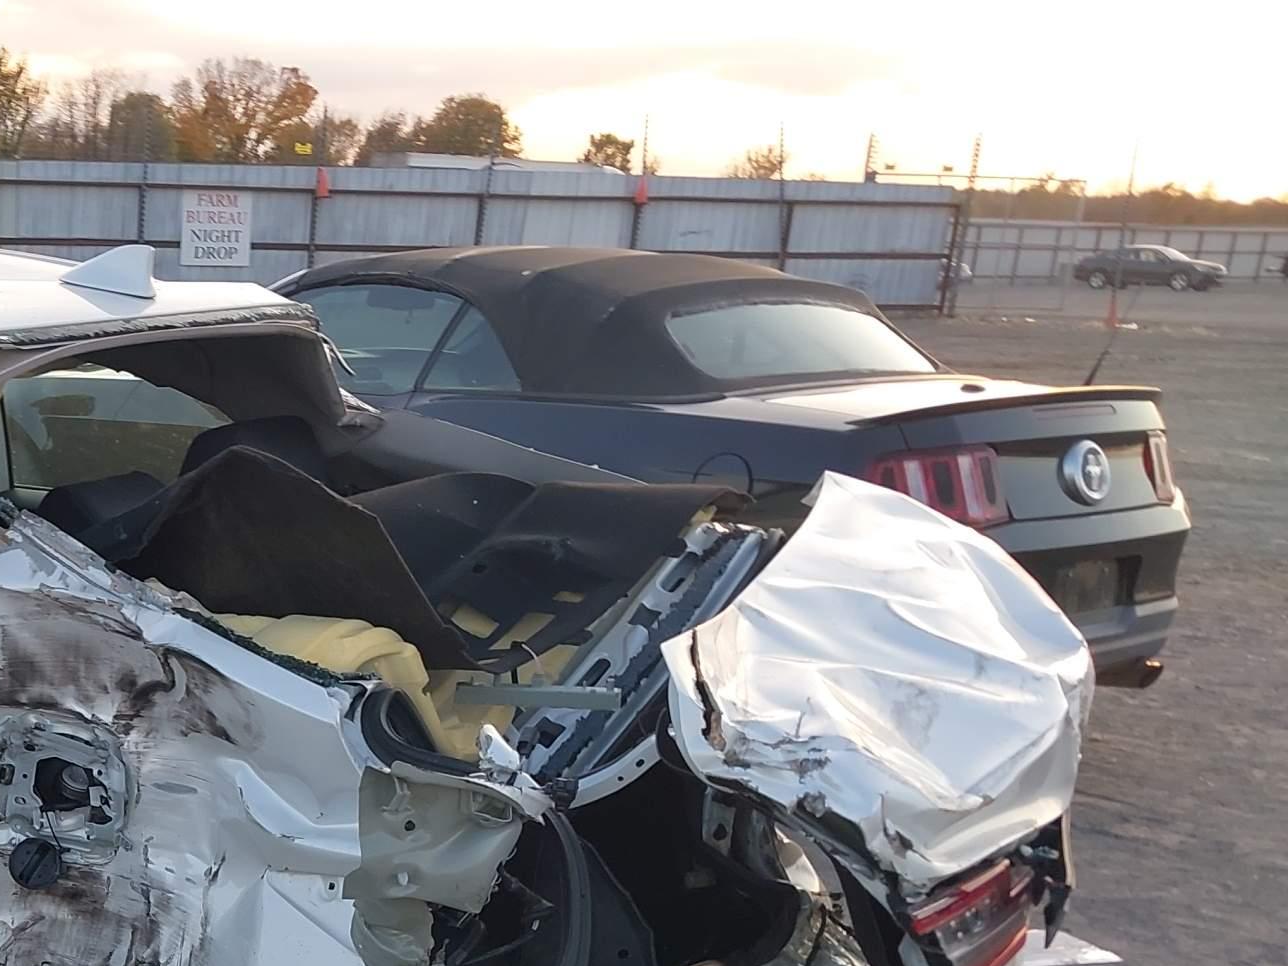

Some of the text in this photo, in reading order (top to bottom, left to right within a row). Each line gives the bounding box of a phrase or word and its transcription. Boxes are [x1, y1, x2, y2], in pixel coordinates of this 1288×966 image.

[196, 193, 240, 208] FARM
[185, 210, 248, 225] BUREAU
[190, 229, 243, 243] NIGHT
[193, 246, 239, 260] DROP
